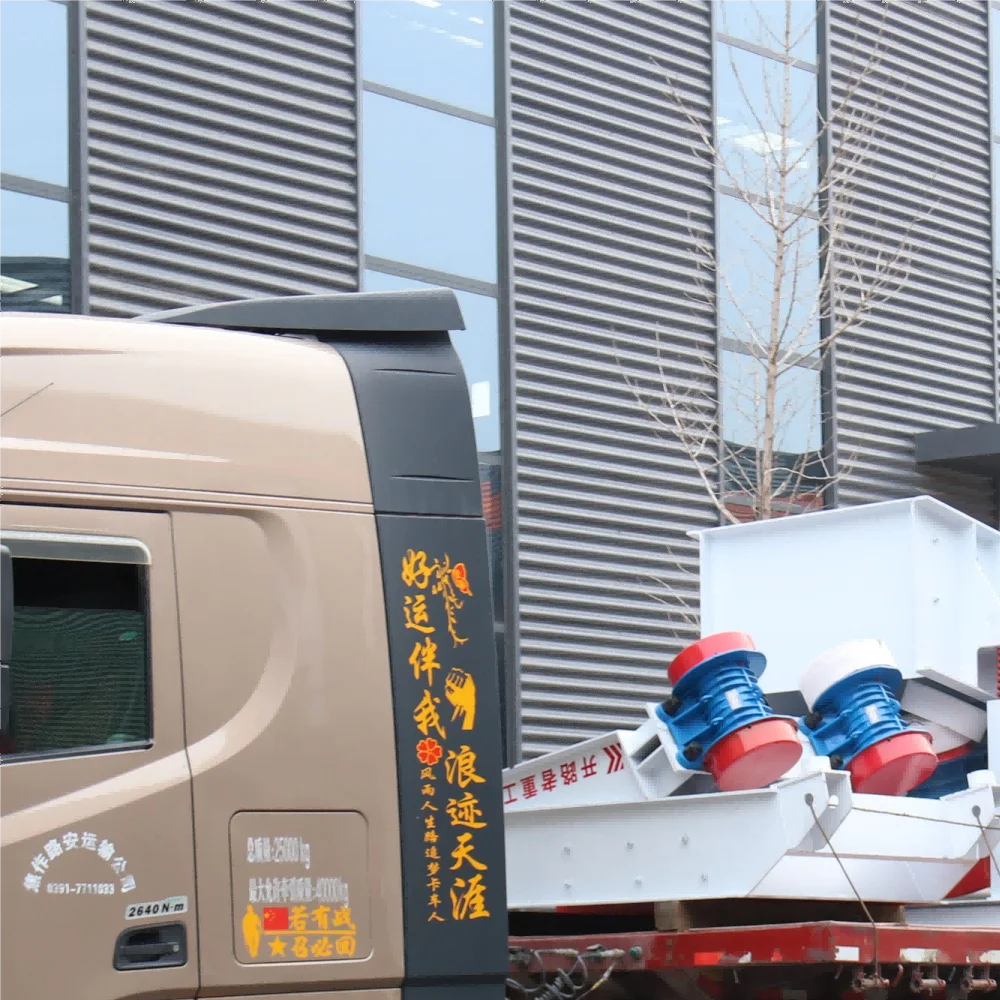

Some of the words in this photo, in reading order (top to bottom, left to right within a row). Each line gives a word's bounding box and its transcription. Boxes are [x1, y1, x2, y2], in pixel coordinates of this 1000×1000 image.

[401, 548, 446, 740] 好运伴我
[444, 745, 491, 921] 浪迹天涯
[502, 754, 598, 805] 开路者重工
[128, 904, 160, 918] 2640
